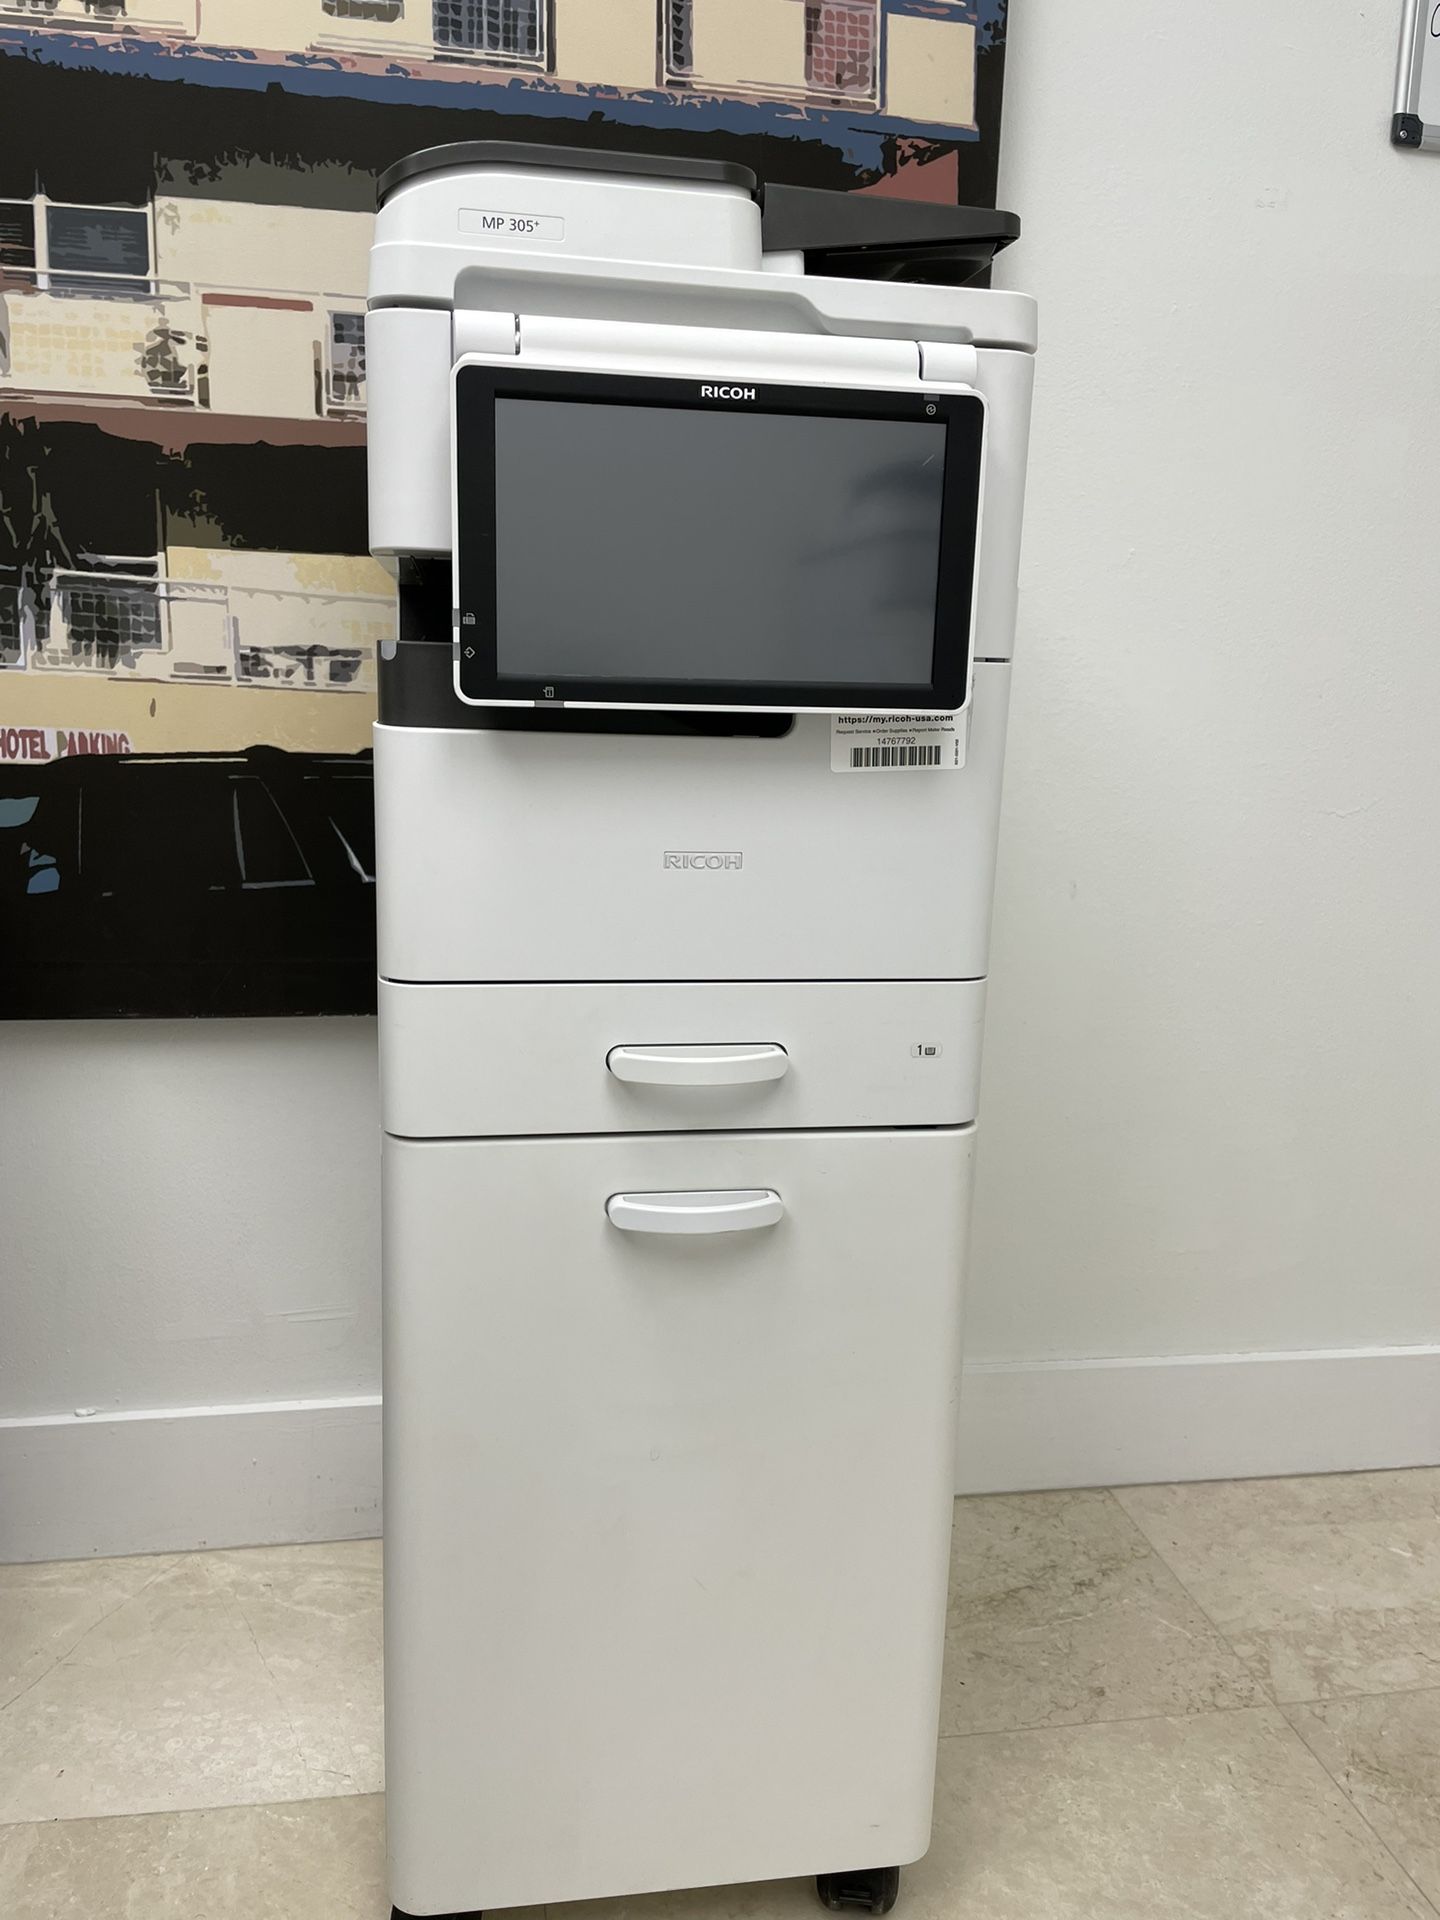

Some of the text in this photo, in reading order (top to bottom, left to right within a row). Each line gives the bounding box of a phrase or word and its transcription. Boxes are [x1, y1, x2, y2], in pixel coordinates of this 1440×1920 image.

[482, 216, 505, 229] MP
[701, 385, 756, 400] RICOH
[838, 715, 954, 724] https://my.ricoh-usa.com
[877, 736, 916, 745] 14767792
[663, 853, 743, 869] RICOH
[917, 1044, 922, 1056] 1
